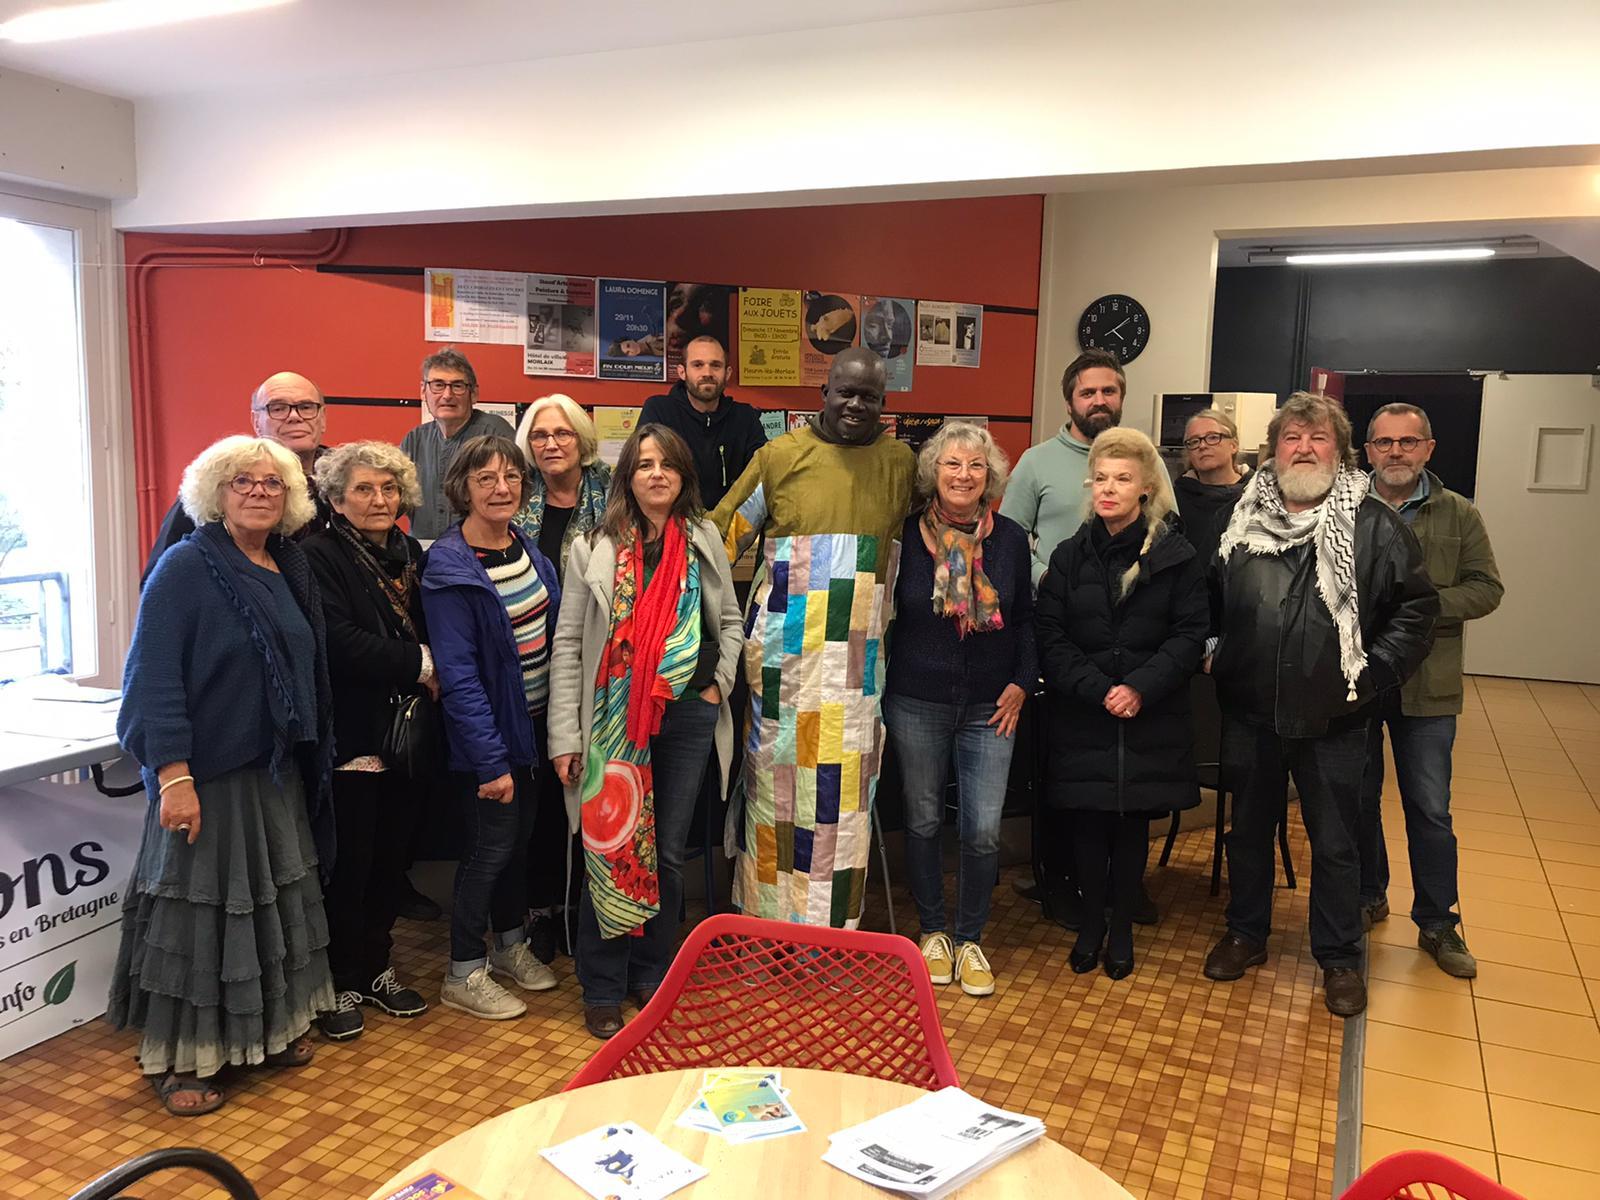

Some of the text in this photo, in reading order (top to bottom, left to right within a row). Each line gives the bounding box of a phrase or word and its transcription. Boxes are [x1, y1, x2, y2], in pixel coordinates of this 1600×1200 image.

[627, 287, 658, 295] DOMENGE
[743, 297, 773, 307] FOIRE
[1112, 302, 1119, 310] 12
[1100, 305, 1106, 313] 11
[1125, 305, 1129, 313] 1
[743, 309, 798, 318] AUX JOUETS
[1091, 314, 1098, 322] 10
[1133, 314, 1139, 322] 2
[1086, 326, 1091, 334] 9
[1136, 326, 1142, 335] 3
[1089, 338, 1095, 347] 8
[1132, 338, 1137, 346] 4
[1122, 347, 1127, 355] 5
[9, 926, 32, 943] en
[34, 891, 120, 933] Bretagne
